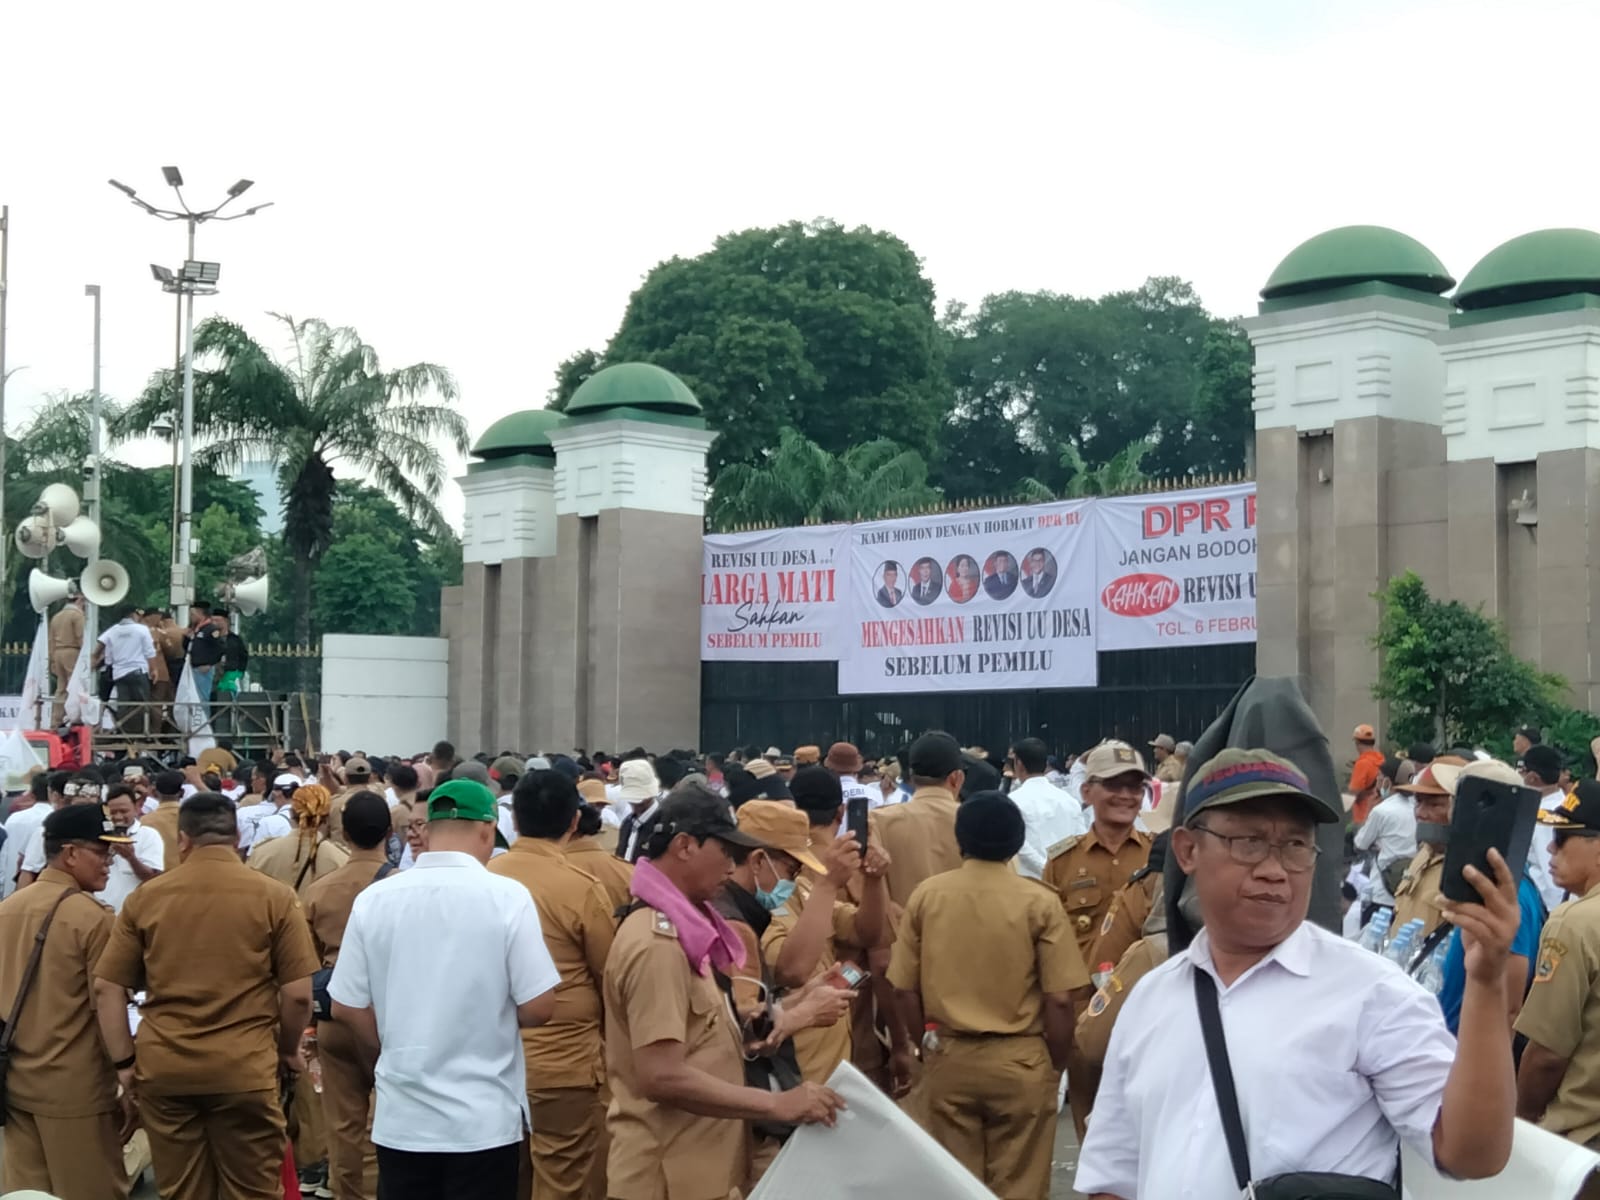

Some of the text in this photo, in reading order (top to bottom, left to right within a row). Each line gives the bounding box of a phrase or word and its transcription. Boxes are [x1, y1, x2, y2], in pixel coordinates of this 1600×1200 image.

[861, 531, 889, 545] KAMI
[892, 527, 932, 542] MOHON
[936, 522, 980, 539] DENGAN
[984, 516, 1034, 534] HORMAT
[1142, 498, 1232, 540] DPR
[712, 552, 756, 568] REVISI
[758, 551, 778, 567] UU
[782, 549, 816, 566] DESA
[1119, 544, 1191, 567] JANGAN
[777, 569, 836, 603] MATI
[1104, 580, 1176, 611] SAHKAN
[1183, 573, 1242, 604] REVISI
[728, 600, 804, 632] Sahkan
[861, 607, 1091, 648] MENGESAHKAN REVISI UU DESA
[1195, 619, 1204, 634] 6
[707, 632, 822, 648] SEBELUM PEMILU
[884, 649, 1053, 677] SEBELUM PEMILU
